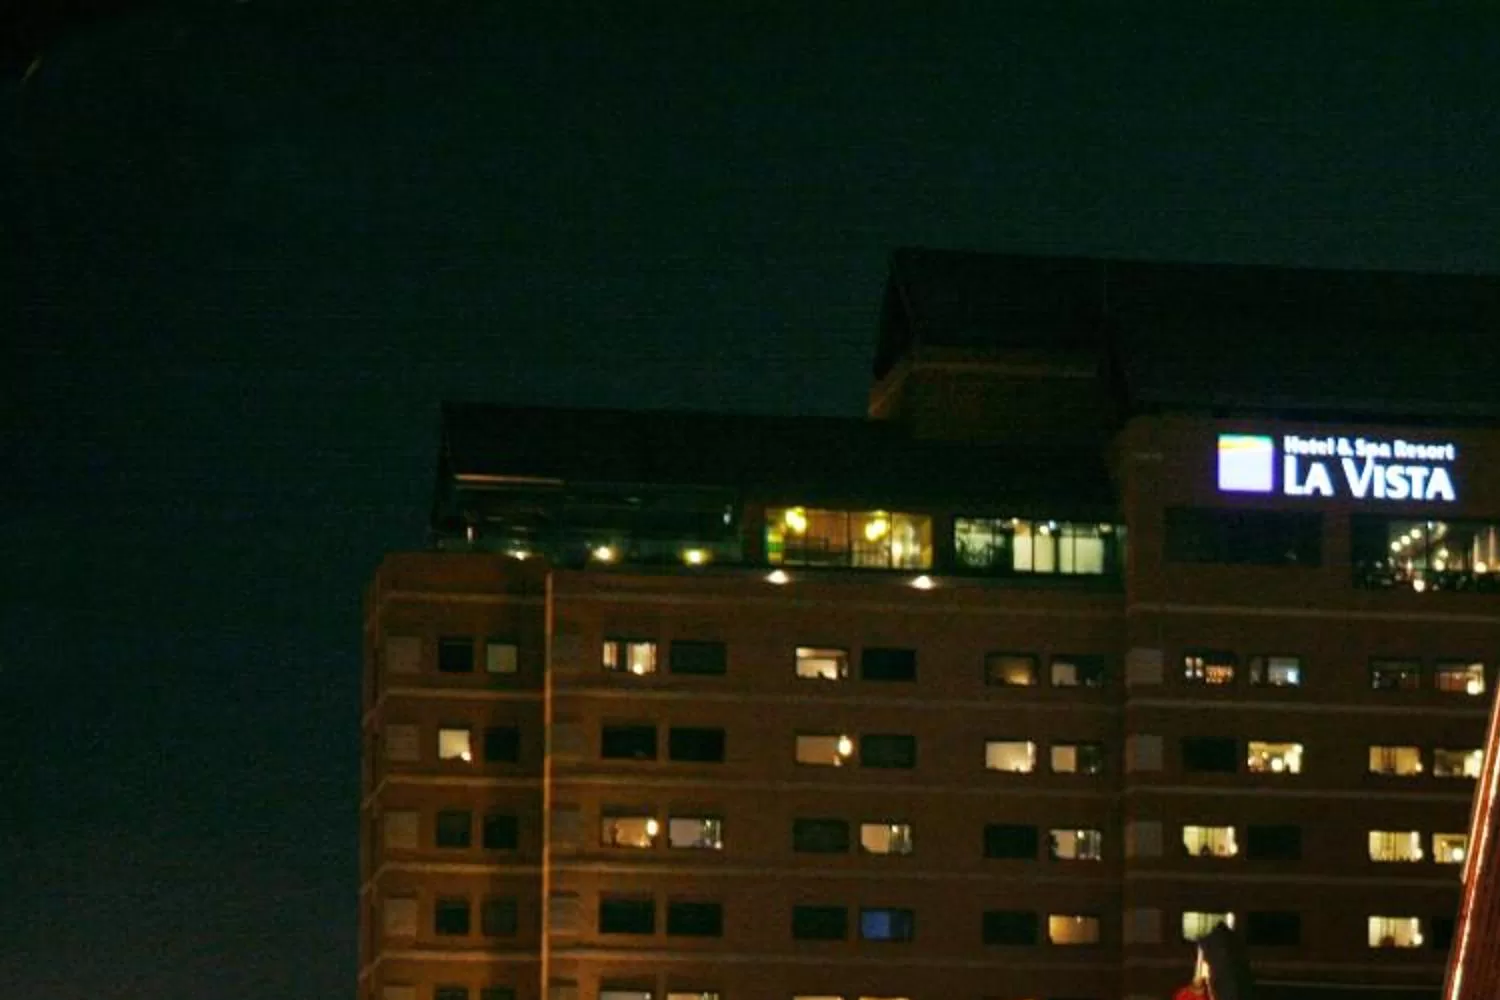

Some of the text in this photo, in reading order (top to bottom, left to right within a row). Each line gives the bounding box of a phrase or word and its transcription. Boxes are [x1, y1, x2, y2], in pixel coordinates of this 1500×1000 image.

[1283, 435, 1456, 461] Hotel & Spa Resort
[1283, 453, 1456, 501] LA VISTA
